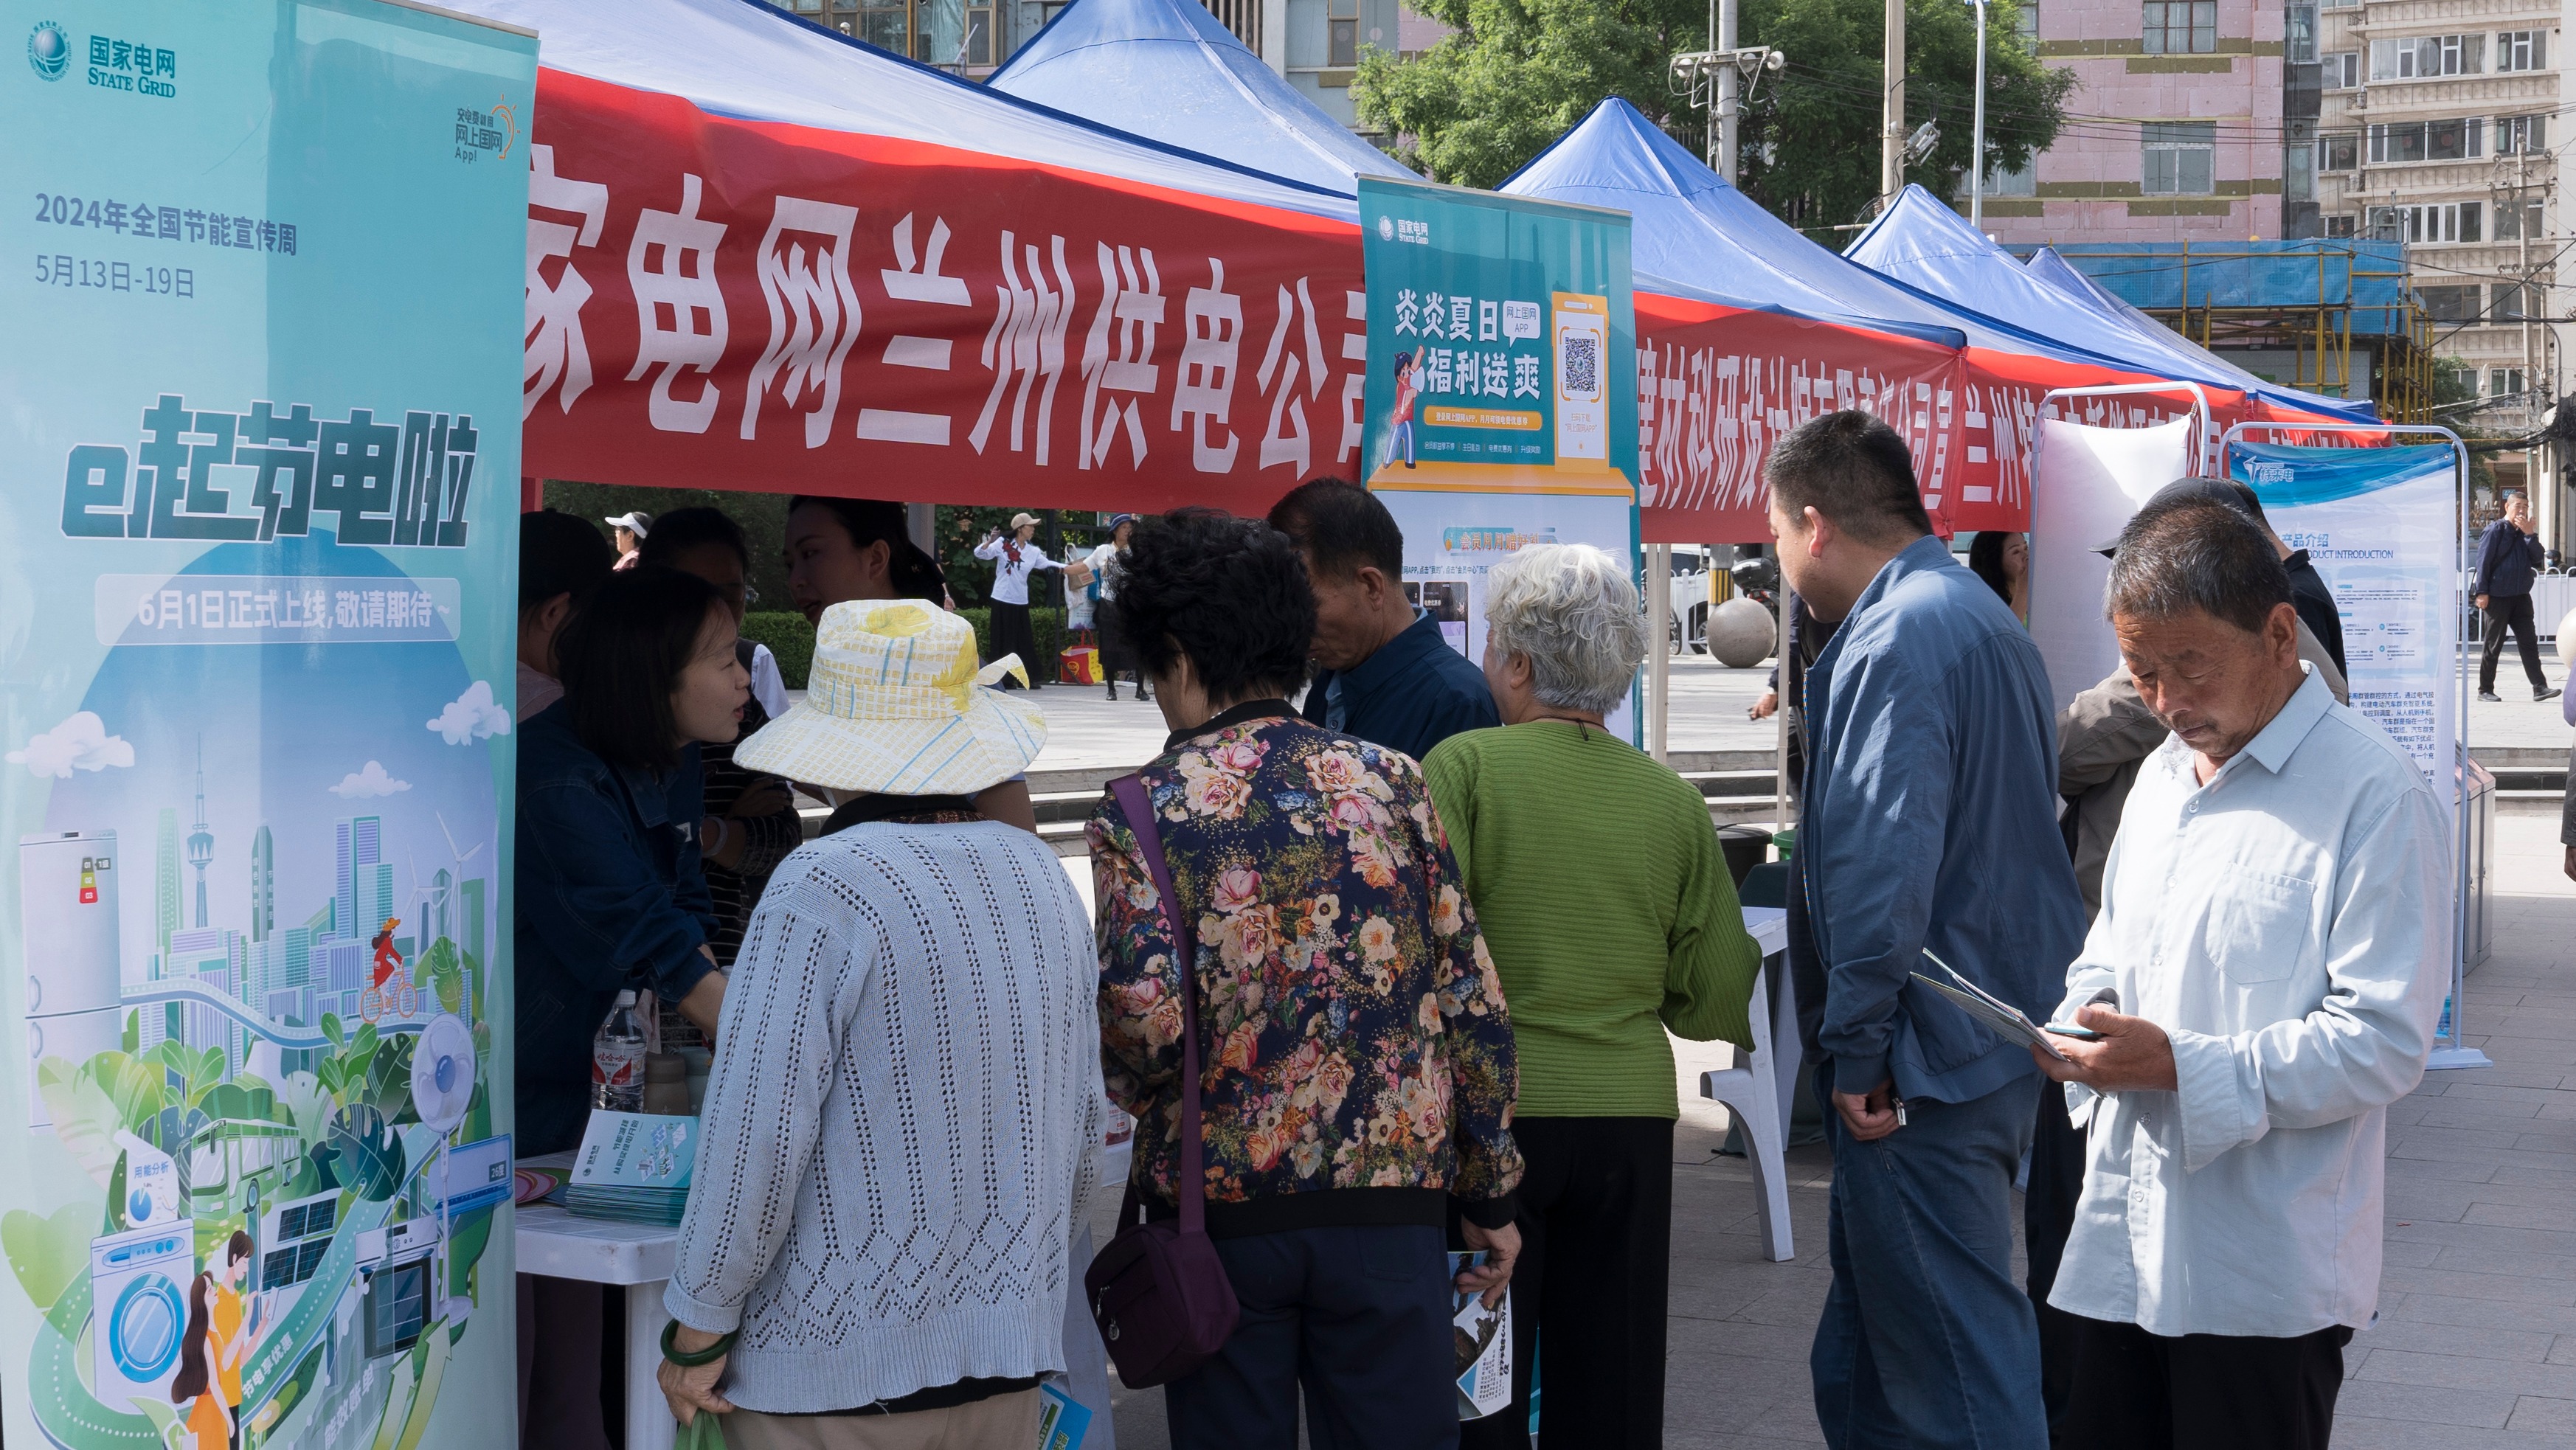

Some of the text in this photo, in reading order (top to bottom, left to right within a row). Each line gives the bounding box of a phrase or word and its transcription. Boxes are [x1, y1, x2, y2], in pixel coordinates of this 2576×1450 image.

[89, 35, 176, 79] 国家电网
[88, 67, 176, 98] STATE GRID
[456, 123, 502, 153] 网上国网
[455, 146, 477, 164] App!
[35, 192, 297, 256] 2024年全国节能宣传周
[1398, 219, 1428, 236] 国家电网
[35, 254, 194, 299] 5月13日-19日
[523, 143, 1365, 480] 家电网兰州供电公
[1395, 288, 1498, 342] 炎炎夏日
[1506, 306, 1537, 320] 网上国网
[1514, 323, 1528, 333] APP
[1427, 347, 1540, 400] 福利送爽
[60, 393, 479, 548] e起节电啦
[2260, 468, 2294, 482] 特来电
[2282, 533, 2328, 547] 产品介绍
[2309, 549, 2393, 559] ODUCT INTRODUCTION
[134, 1161, 169, 1179] 用能分析
[491, 1164, 505, 1178] 26度
[242, 1331, 294, 1399] 节电享优惠
[325, 1363, 375, 1450] 能效账单
